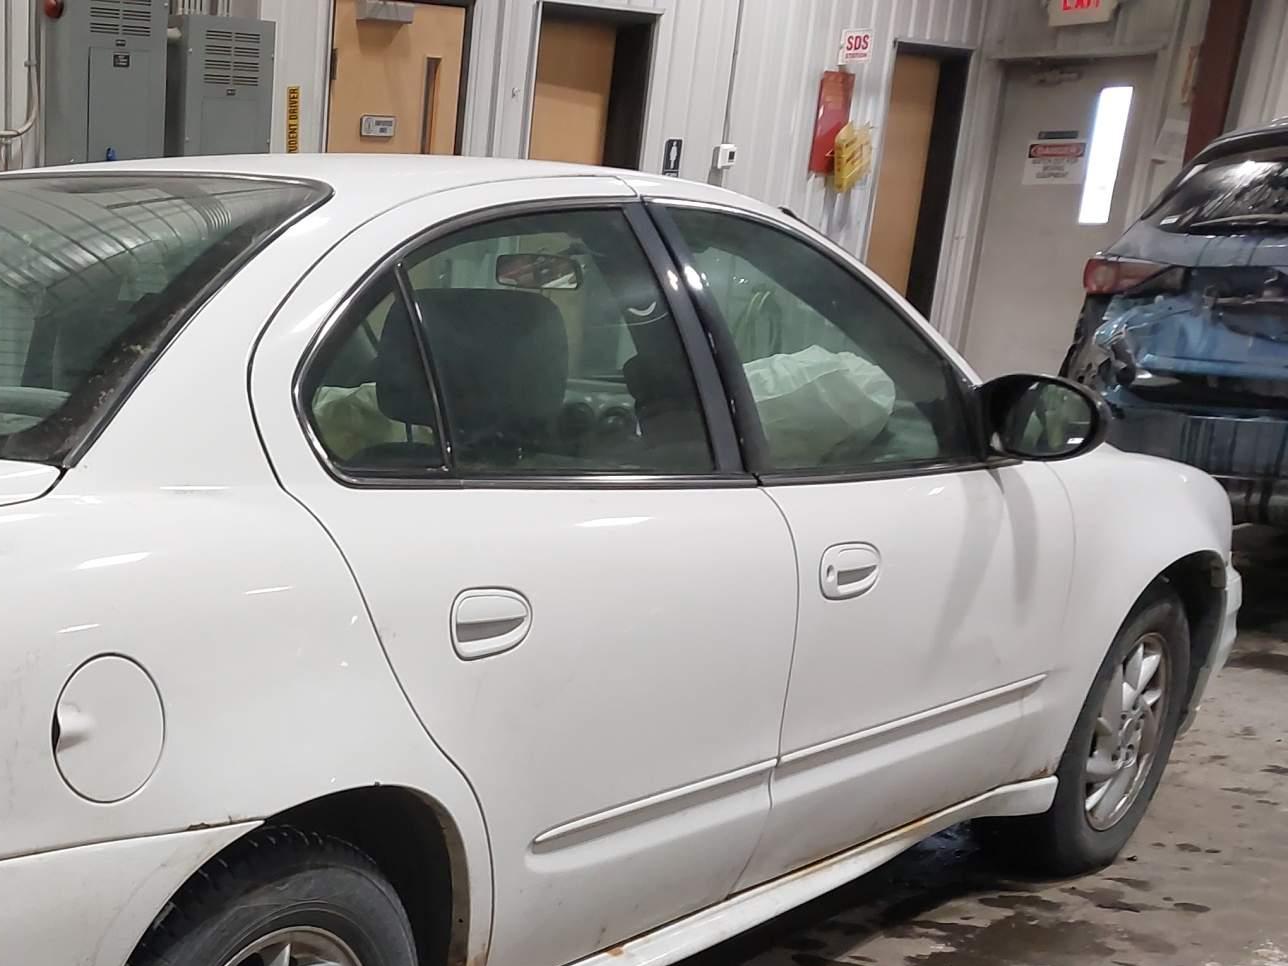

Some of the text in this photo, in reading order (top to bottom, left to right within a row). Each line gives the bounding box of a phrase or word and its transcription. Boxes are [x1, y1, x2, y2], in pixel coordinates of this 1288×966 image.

[846, 34, 870, 50] SDS
[288, 88, 298, 154] UDENT DRIVER
